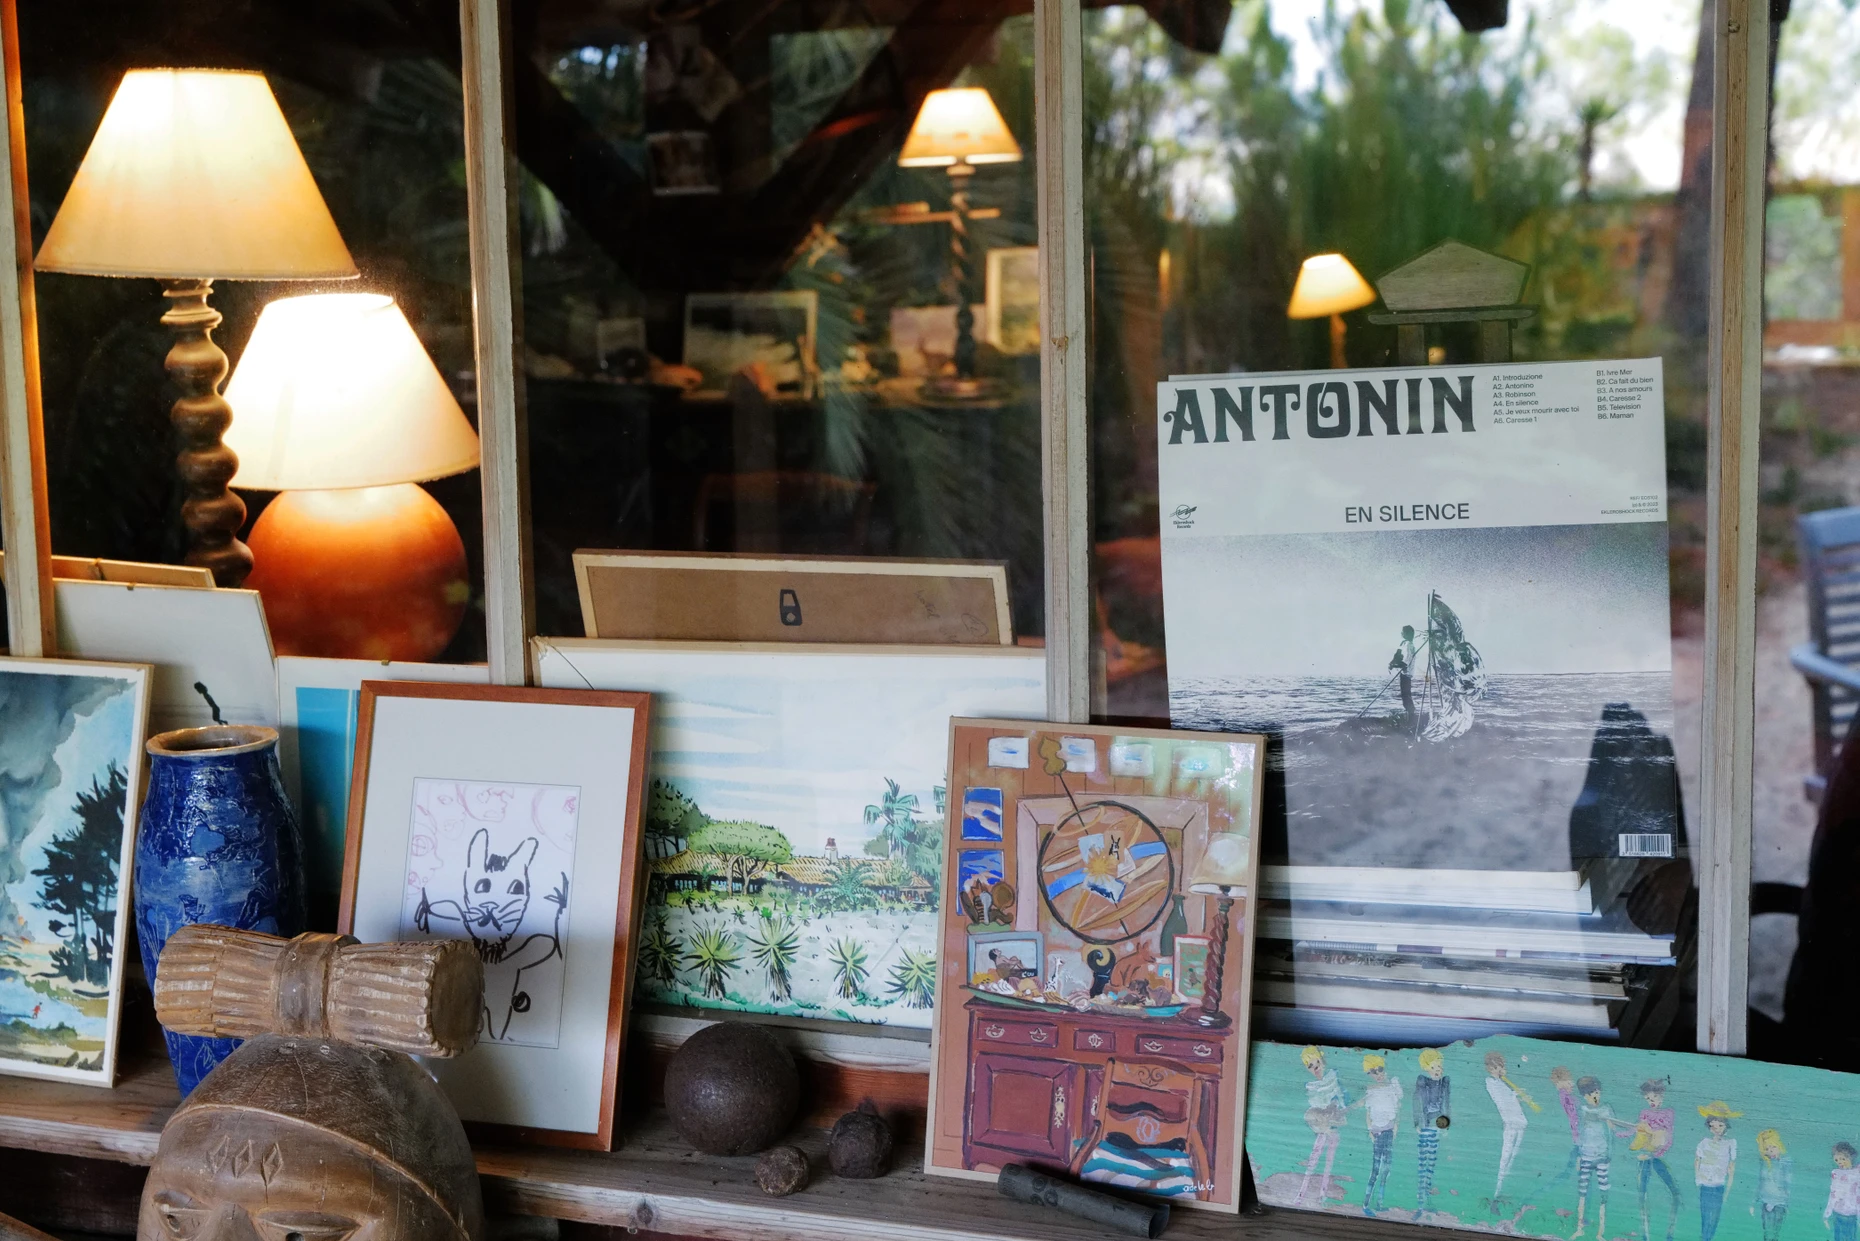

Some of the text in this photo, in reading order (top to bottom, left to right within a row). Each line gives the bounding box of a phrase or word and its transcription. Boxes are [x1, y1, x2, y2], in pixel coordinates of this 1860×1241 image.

[1502, 373, 1543, 381] Introduzione
[1596, 378, 1607, 386] B2.
[1619, 377, 1629, 385] fait
[1639, 376, 1654, 384] bien
[1505, 382, 1535, 390] Antonino
[1515, 399, 1539, 407] silence
[1163, 375, 1477, 445] ANTONIN
[1609, 412, 1635, 420] Maman
[1345, 502, 1470, 524] EN SILENCE
